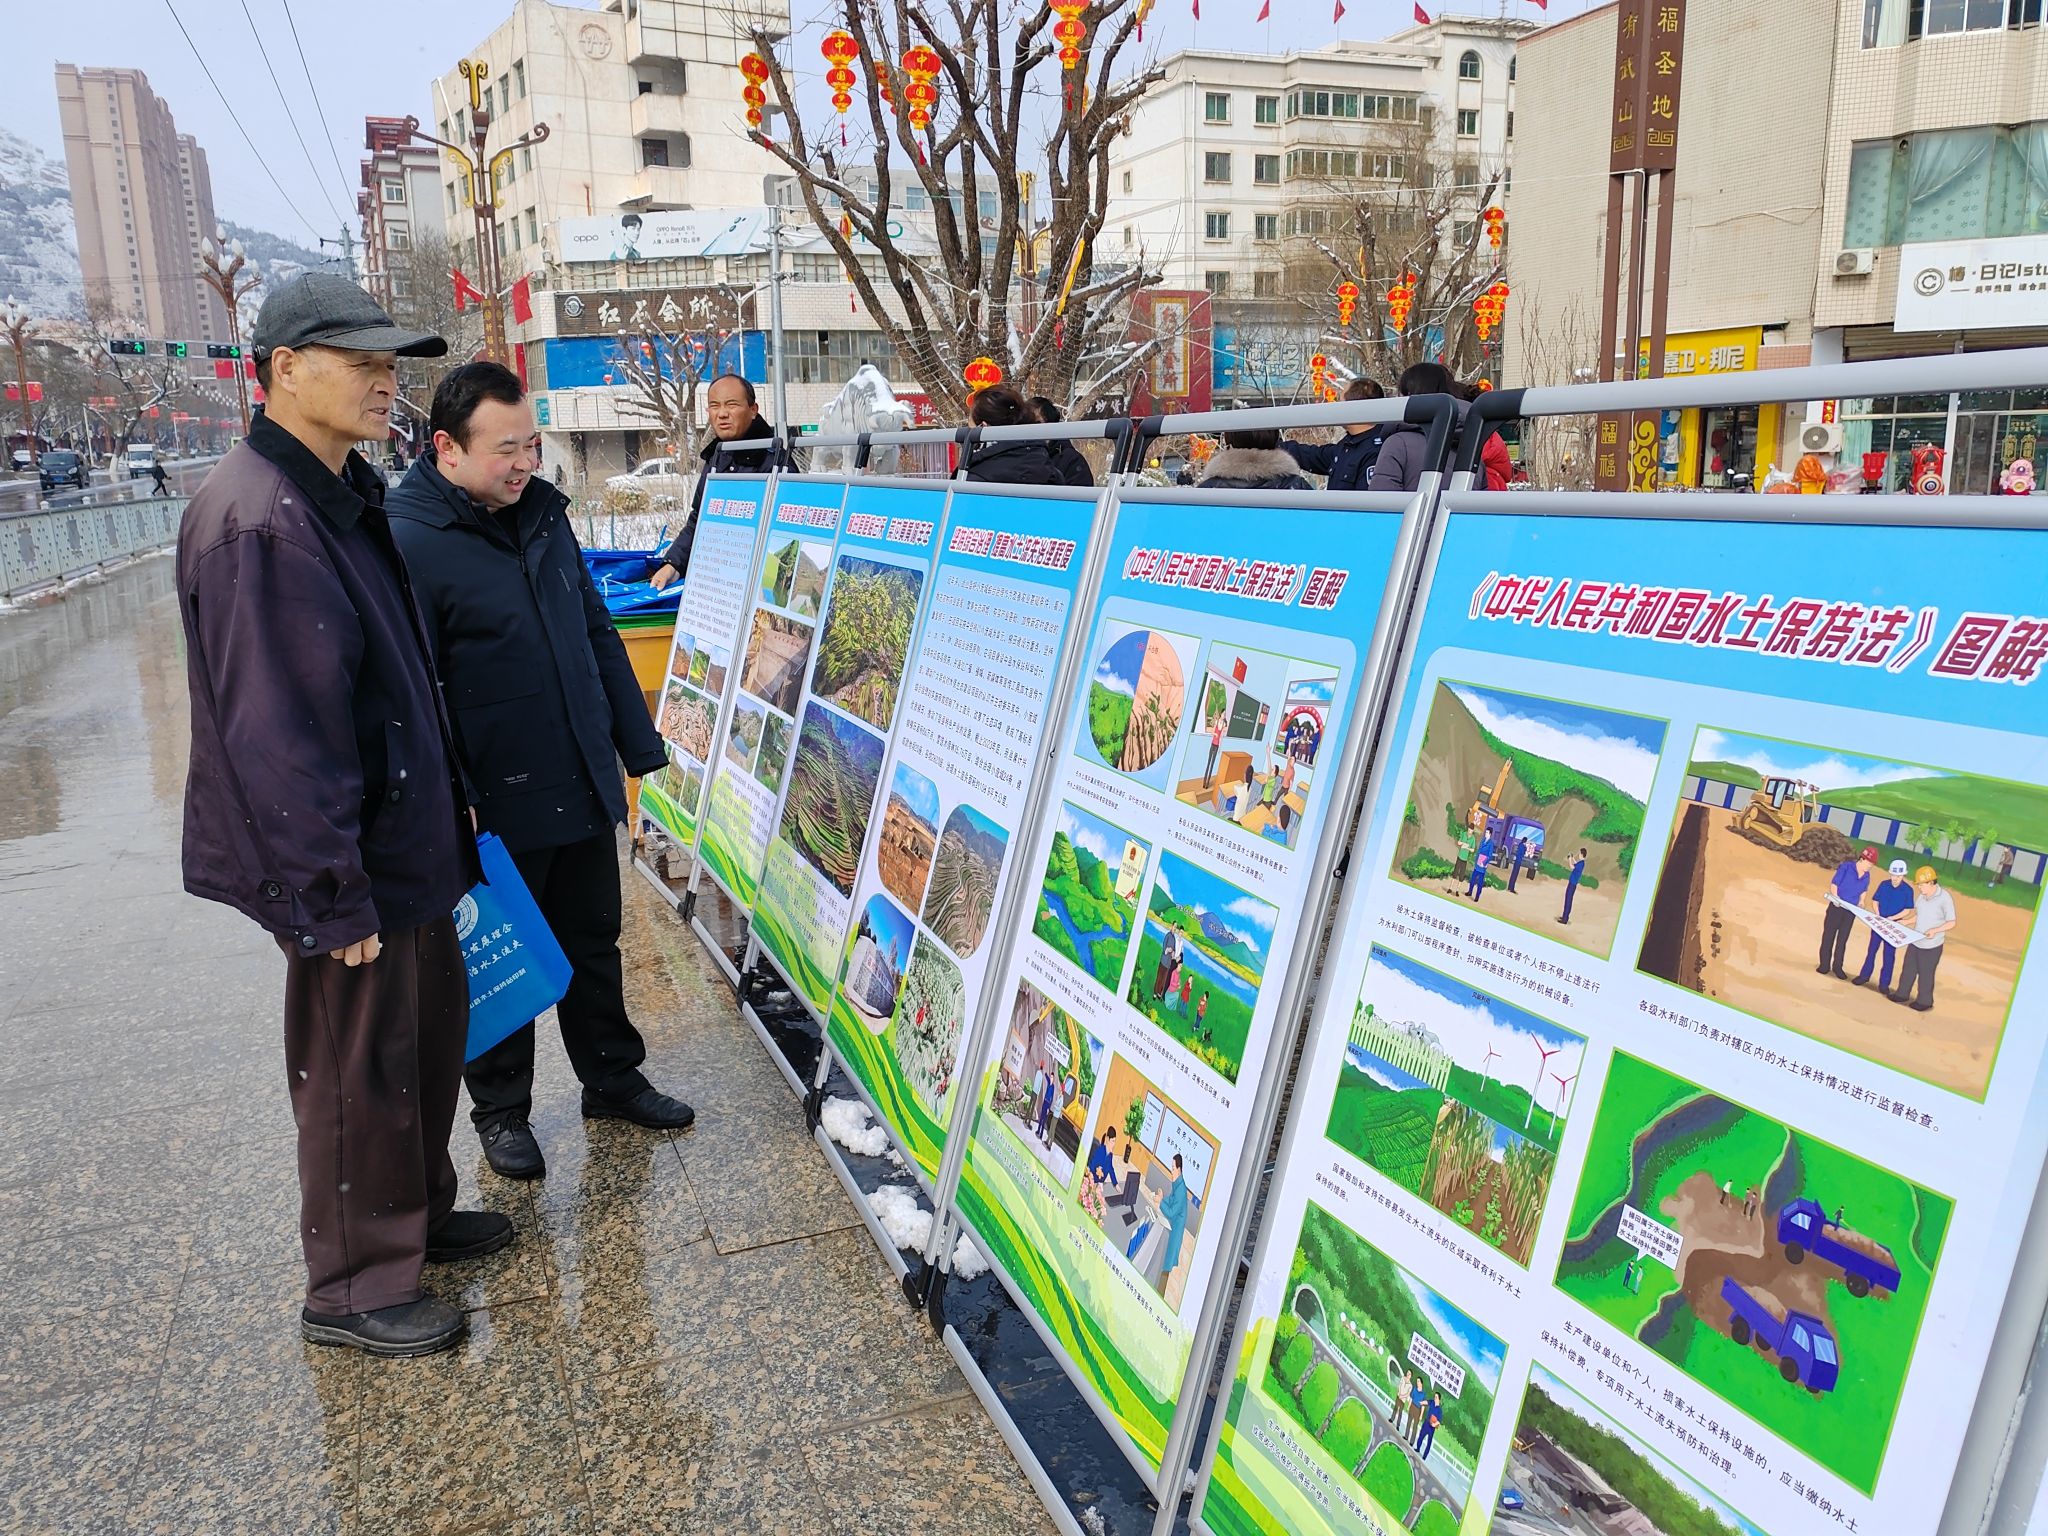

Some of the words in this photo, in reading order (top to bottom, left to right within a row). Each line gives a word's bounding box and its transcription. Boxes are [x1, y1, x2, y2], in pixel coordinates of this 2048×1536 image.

[573, 234, 599, 243] oppo
[1470, 571, 2048, 684] 《中华人民共和国水土保持法》图解
[1638, 999, 1940, 1134] 各级水利部门负责对辖区内的水土保持情况进行监督检查。
[1314, 1171, 1349, 1203] 保持的措施。
[1331, 1162, 1522, 1300] 国家鼓励和支持在容易发生水土流失的区域采取有利于水土
[1628, 1210, 1680, 1246] 梯田属于水土保持
[1540, 1329, 1739, 1481] 保持补偿费，专项用于水土流失预防和治理。
[1562, 1319, 1859, 1535] 生产建设单位和个人，损害水土保持设施的，应当缴纳水土
